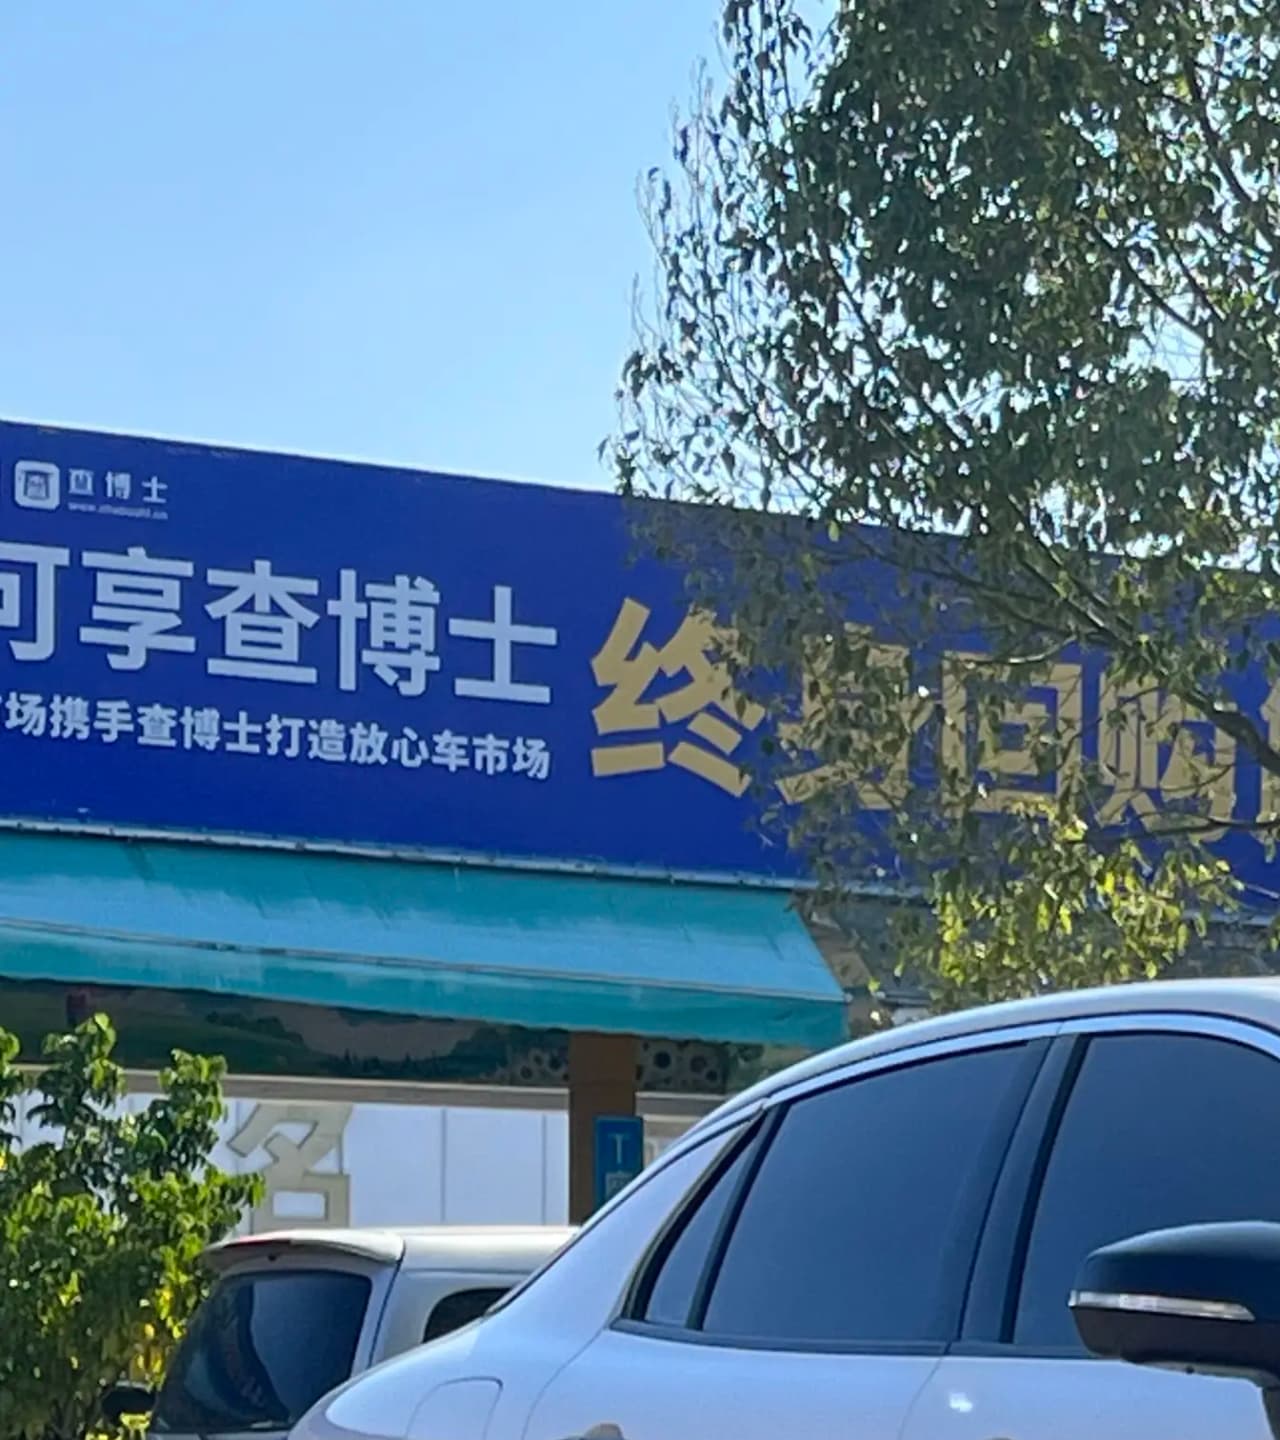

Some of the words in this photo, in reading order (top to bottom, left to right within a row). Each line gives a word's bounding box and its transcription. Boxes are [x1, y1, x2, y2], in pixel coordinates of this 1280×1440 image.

[0, 541, 558, 705] 可享查博士
[4, 692, 551, 780] 场携手查博士打造放心车市场
